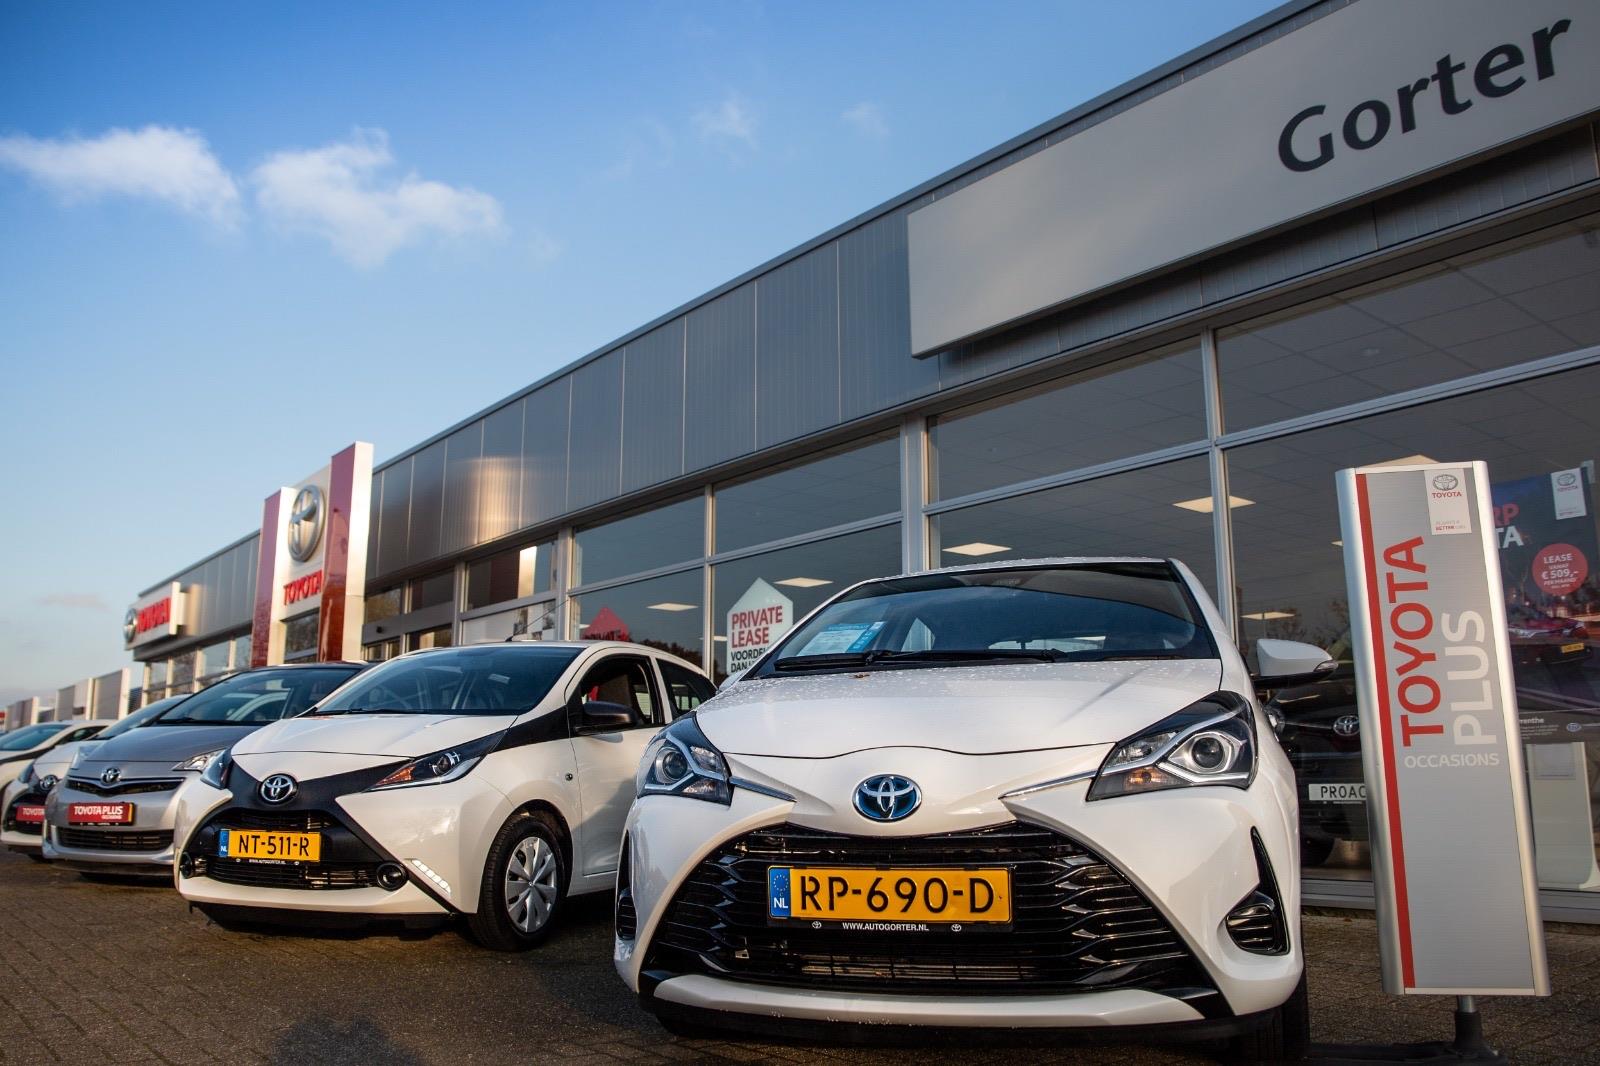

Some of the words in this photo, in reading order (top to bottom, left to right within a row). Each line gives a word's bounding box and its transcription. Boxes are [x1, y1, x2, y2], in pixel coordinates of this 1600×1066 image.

[1278, 19, 1572, 172] Gorter
[1432, 491, 1462, 499] TOYOTA
[1543, 553, 1573, 564] LEASE
[283, 569, 324, 606] TOYOTA
[731, 605, 783, 630] PRIVATE
[731, 627, 769, 649] LEASE
[1383, 536, 1444, 747] TOYOTA
[1440, 610, 1498, 745] PLUS
[1404, 753, 1500, 769] OCCASIONS
[74, 805, 102, 815] TOYOTA
[102, 805, 124, 815] PLUS
[238, 834, 310, 857] NT-511-R
[773, 897, 789, 910] NL
[800, 874, 995, 914] RP-690-D
[842, 921, 930, 932] WWW.AUTOGORTER.NL
